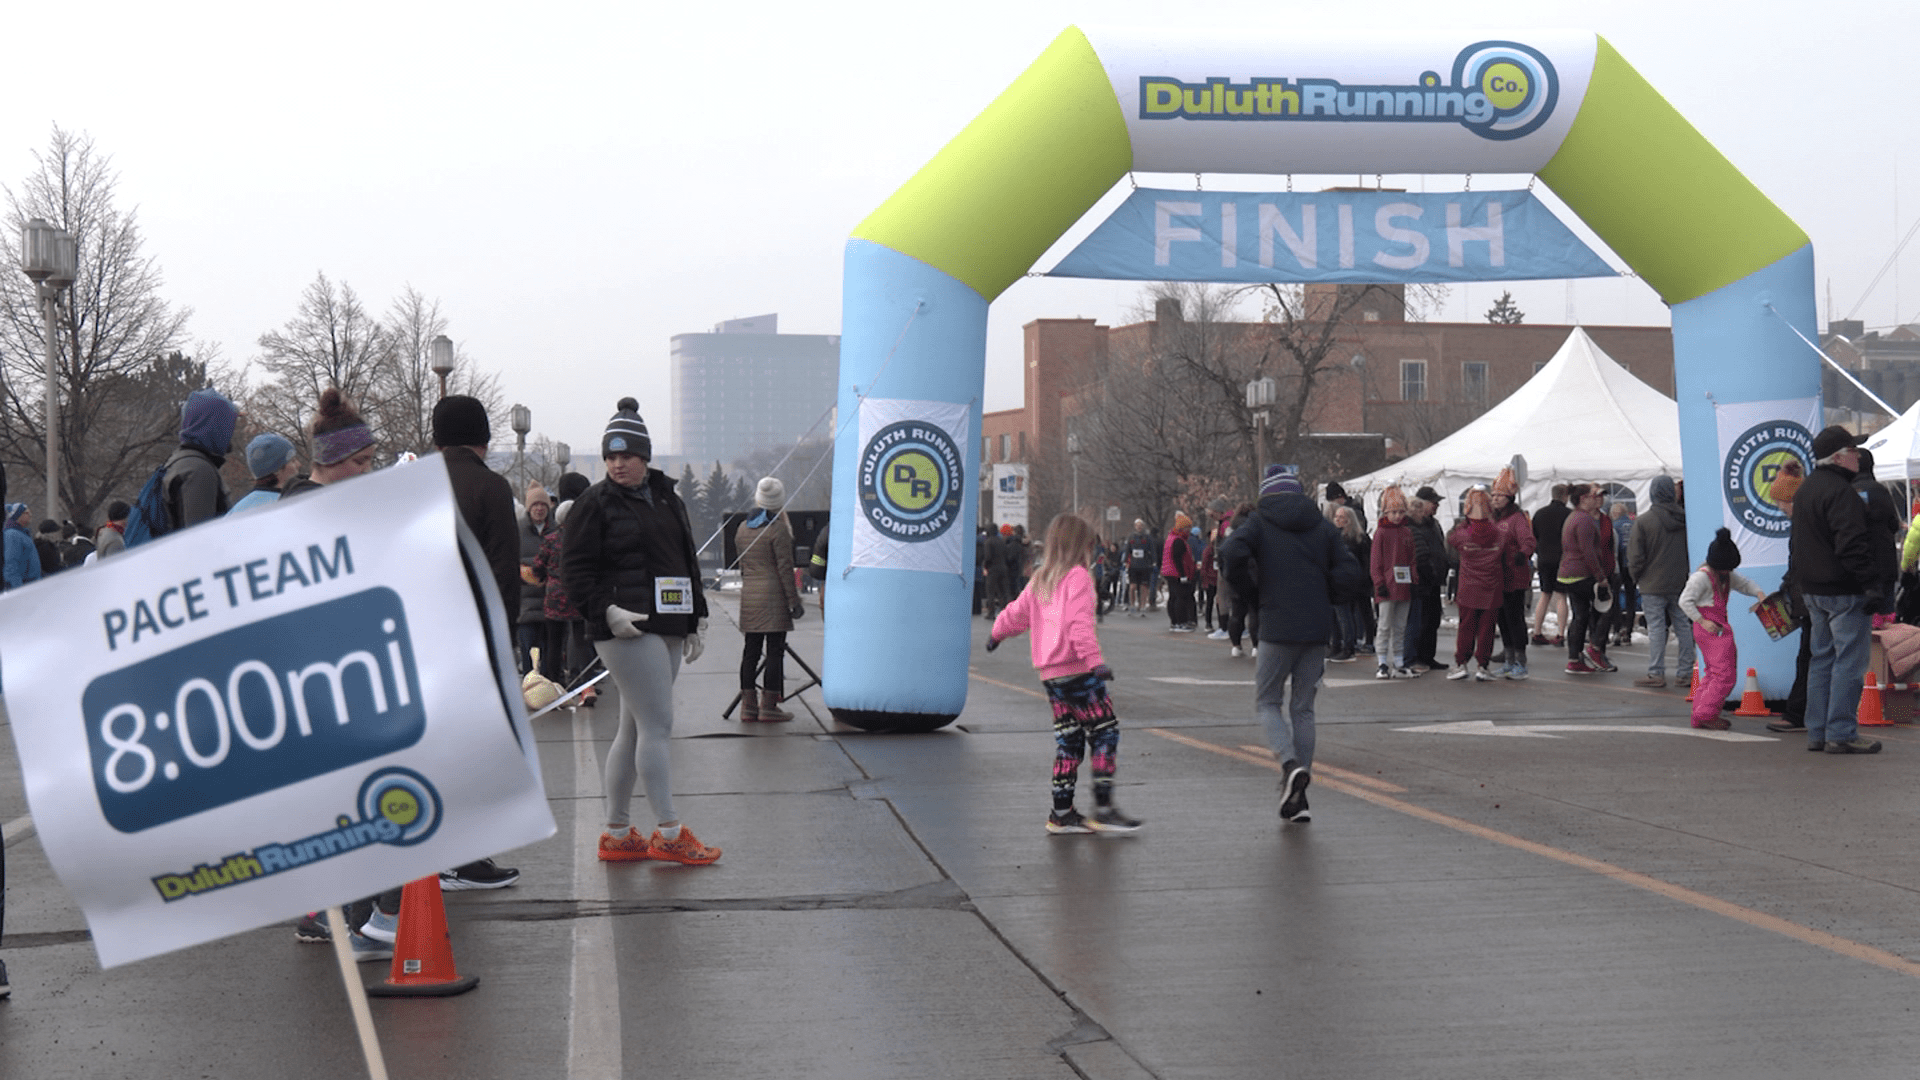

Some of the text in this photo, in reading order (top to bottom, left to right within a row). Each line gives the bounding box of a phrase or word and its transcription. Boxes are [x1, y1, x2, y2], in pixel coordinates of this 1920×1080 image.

[1490, 76, 1524, 93] Co.
[1154, 201, 1504, 269] FINISH
[864, 428, 959, 491] DULUTH RUNNING
[1730, 430, 1770, 489] DULUTH
[872, 507, 949, 535] COMPANY
[1743, 509, 1792, 531] COMP
[103, 535, 354, 651] PACE TEAM
[101, 618, 410, 794] 8:00mi
